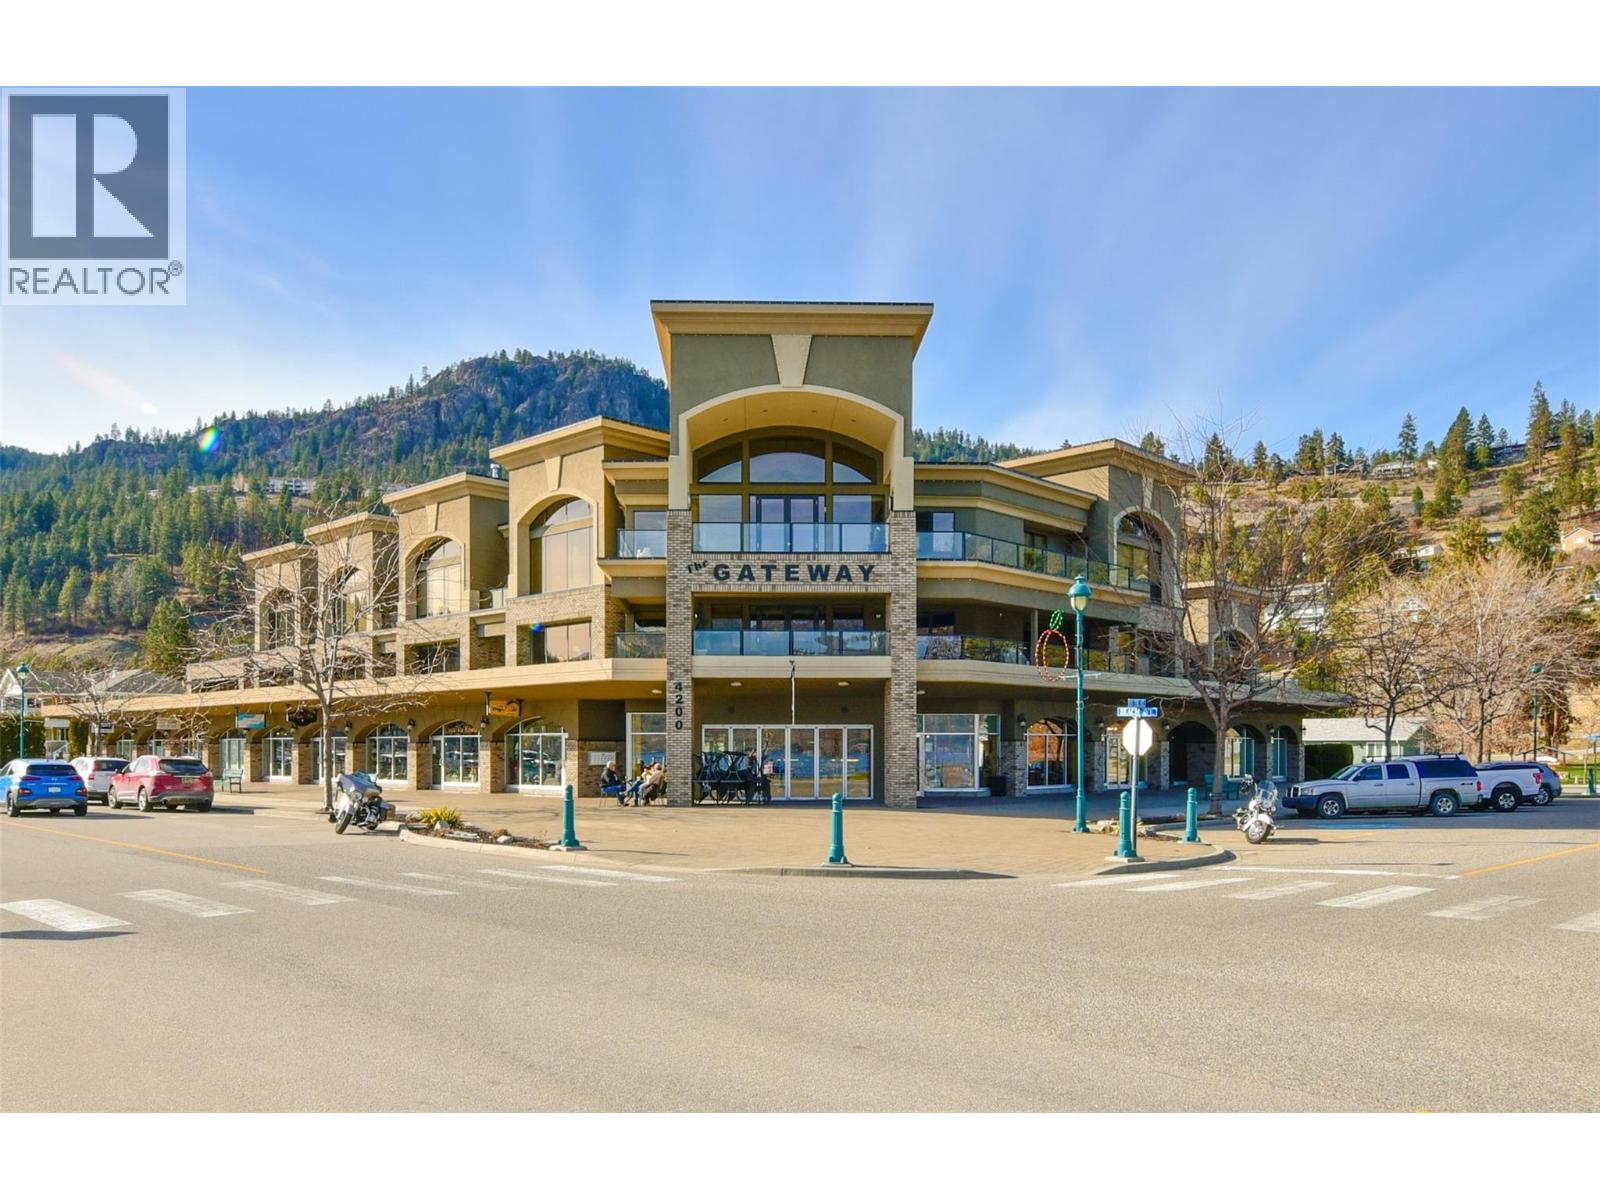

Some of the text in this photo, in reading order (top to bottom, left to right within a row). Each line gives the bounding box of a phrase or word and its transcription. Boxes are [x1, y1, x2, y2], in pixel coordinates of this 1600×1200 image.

[686, 560, 875, 582] The GATEWAY
[674, 682, 684, 730] 4200
